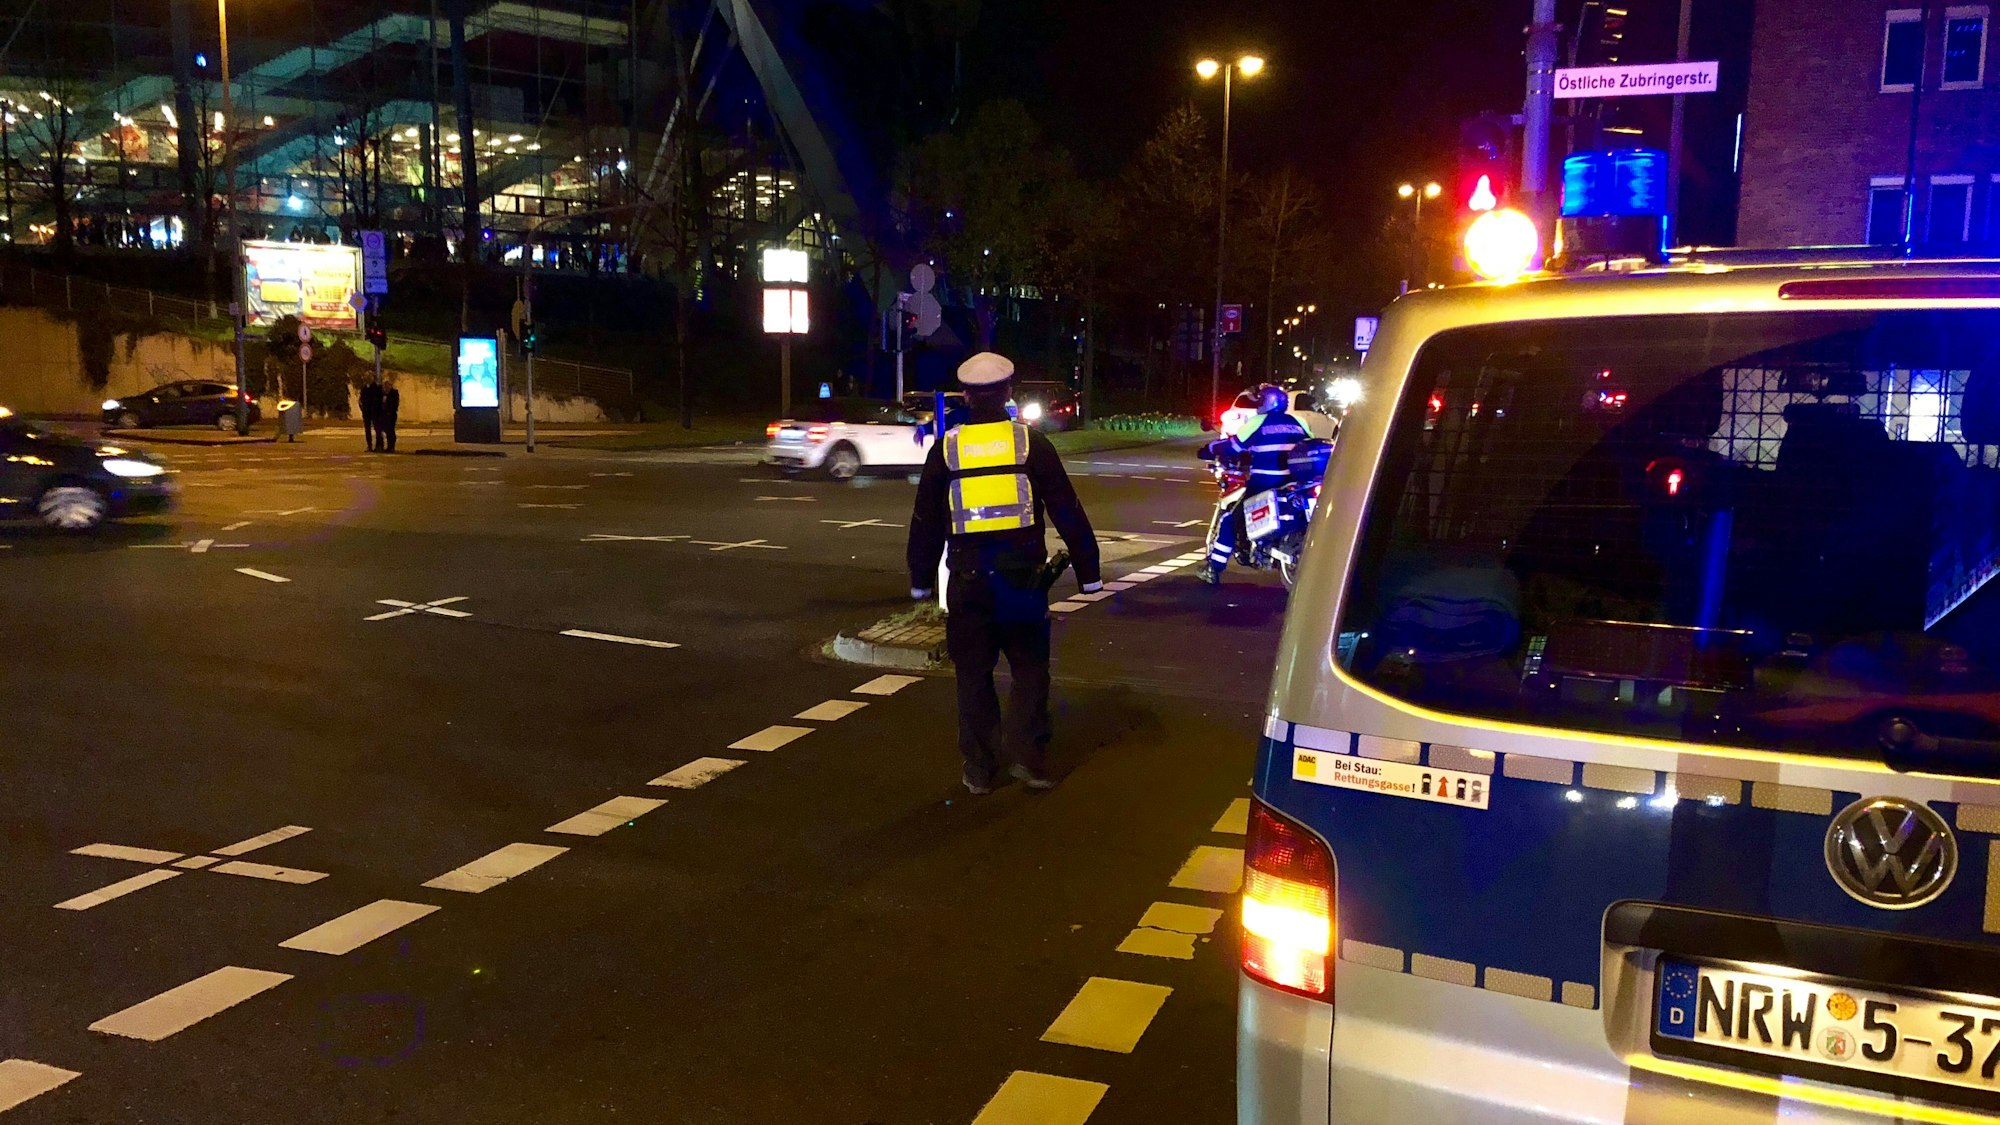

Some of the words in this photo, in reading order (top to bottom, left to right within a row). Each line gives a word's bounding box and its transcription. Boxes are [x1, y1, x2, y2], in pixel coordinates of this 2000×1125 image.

[1559, 73, 1615, 90] Östliche
[1620, 71, 1713, 89] Zubringerstr.
[1298, 754, 1317, 765] ADAC
[1335, 759, 1352, 771] Bei
[1354, 762, 1383, 776] Stau:
[1334, 771, 1416, 793] Rettungsgasse!
[1669, 1007, 1684, 1025] D
[1699, 976, 1817, 1050] NRW
